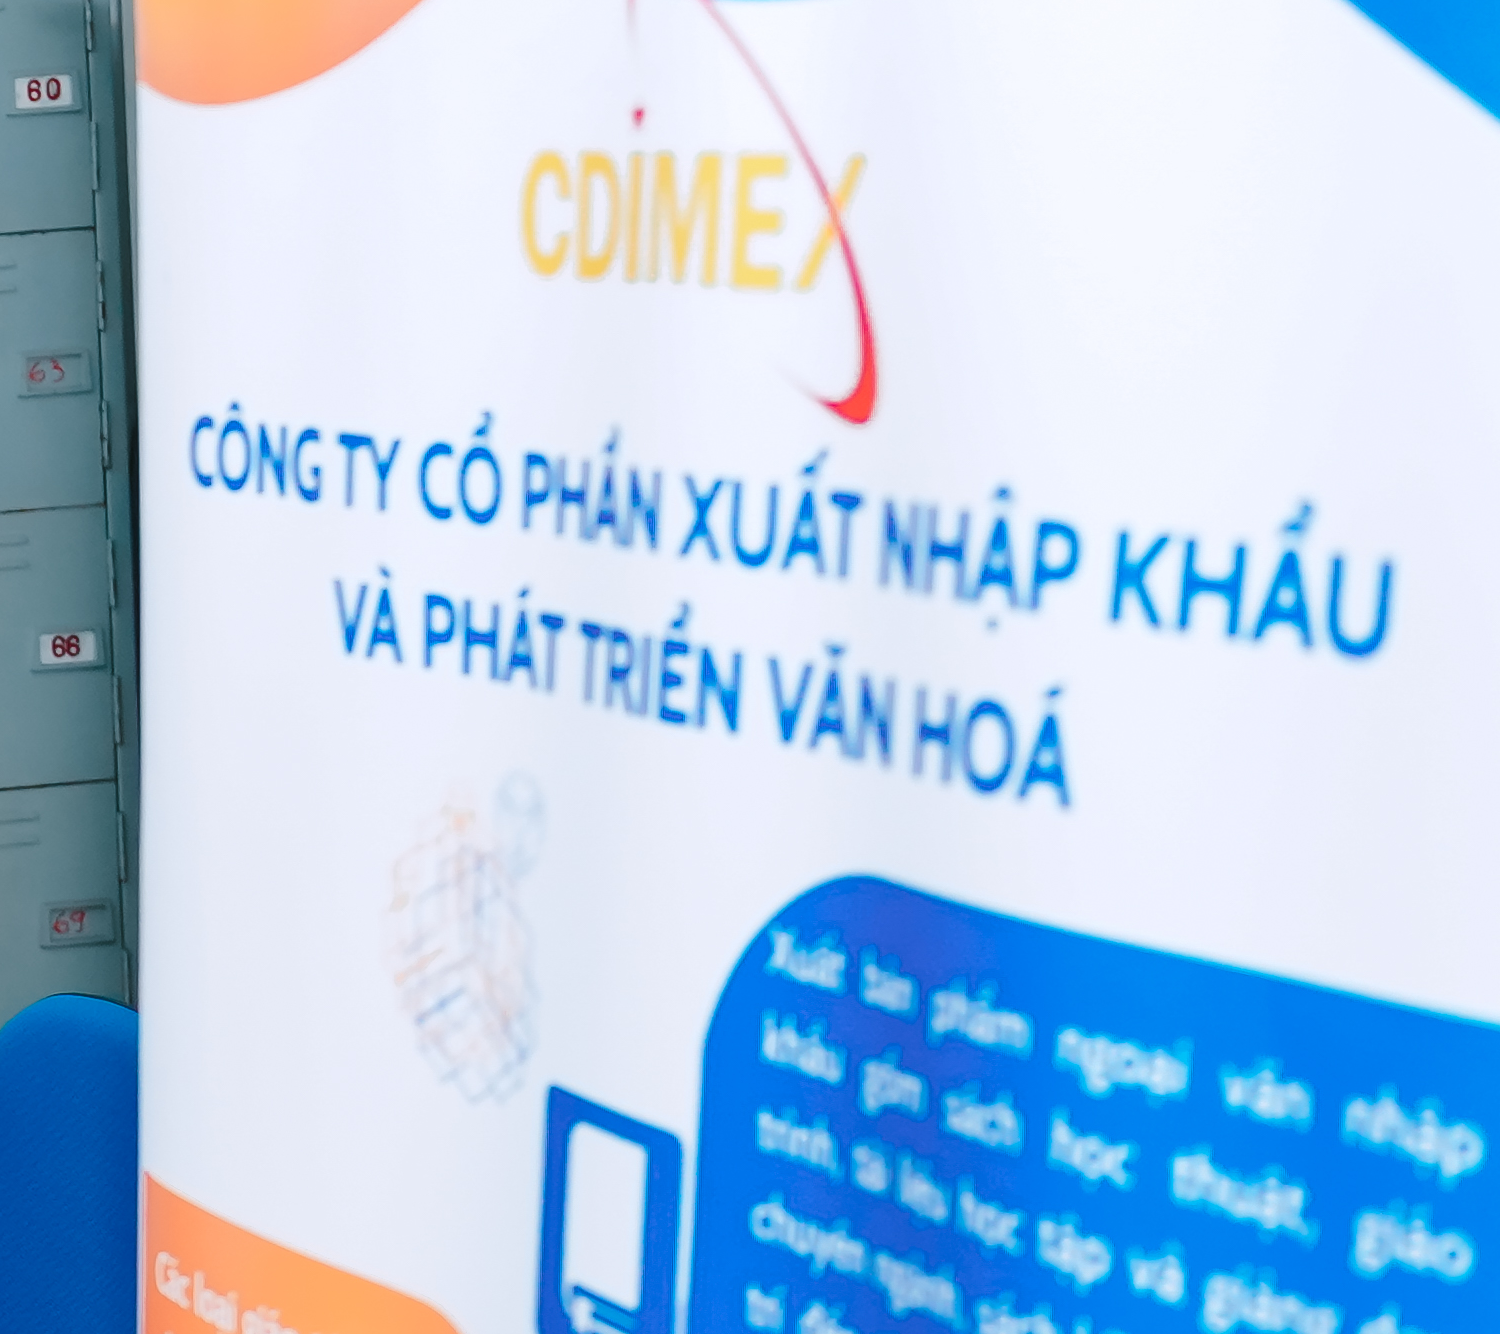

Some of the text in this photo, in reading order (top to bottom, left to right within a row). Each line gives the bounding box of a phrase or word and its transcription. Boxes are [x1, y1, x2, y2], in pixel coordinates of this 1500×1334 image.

[26, 76, 63, 103] 60
[27, 359, 68, 385] 63
[188, 402, 1398, 660] CÔNG TY CỔ PHẦN XUẤT NHẬP KHẨU
[51, 635, 81, 659] 66
[333, 566, 1074, 812] VÀ PHÁT TRIỂN VĂN HOÁ
